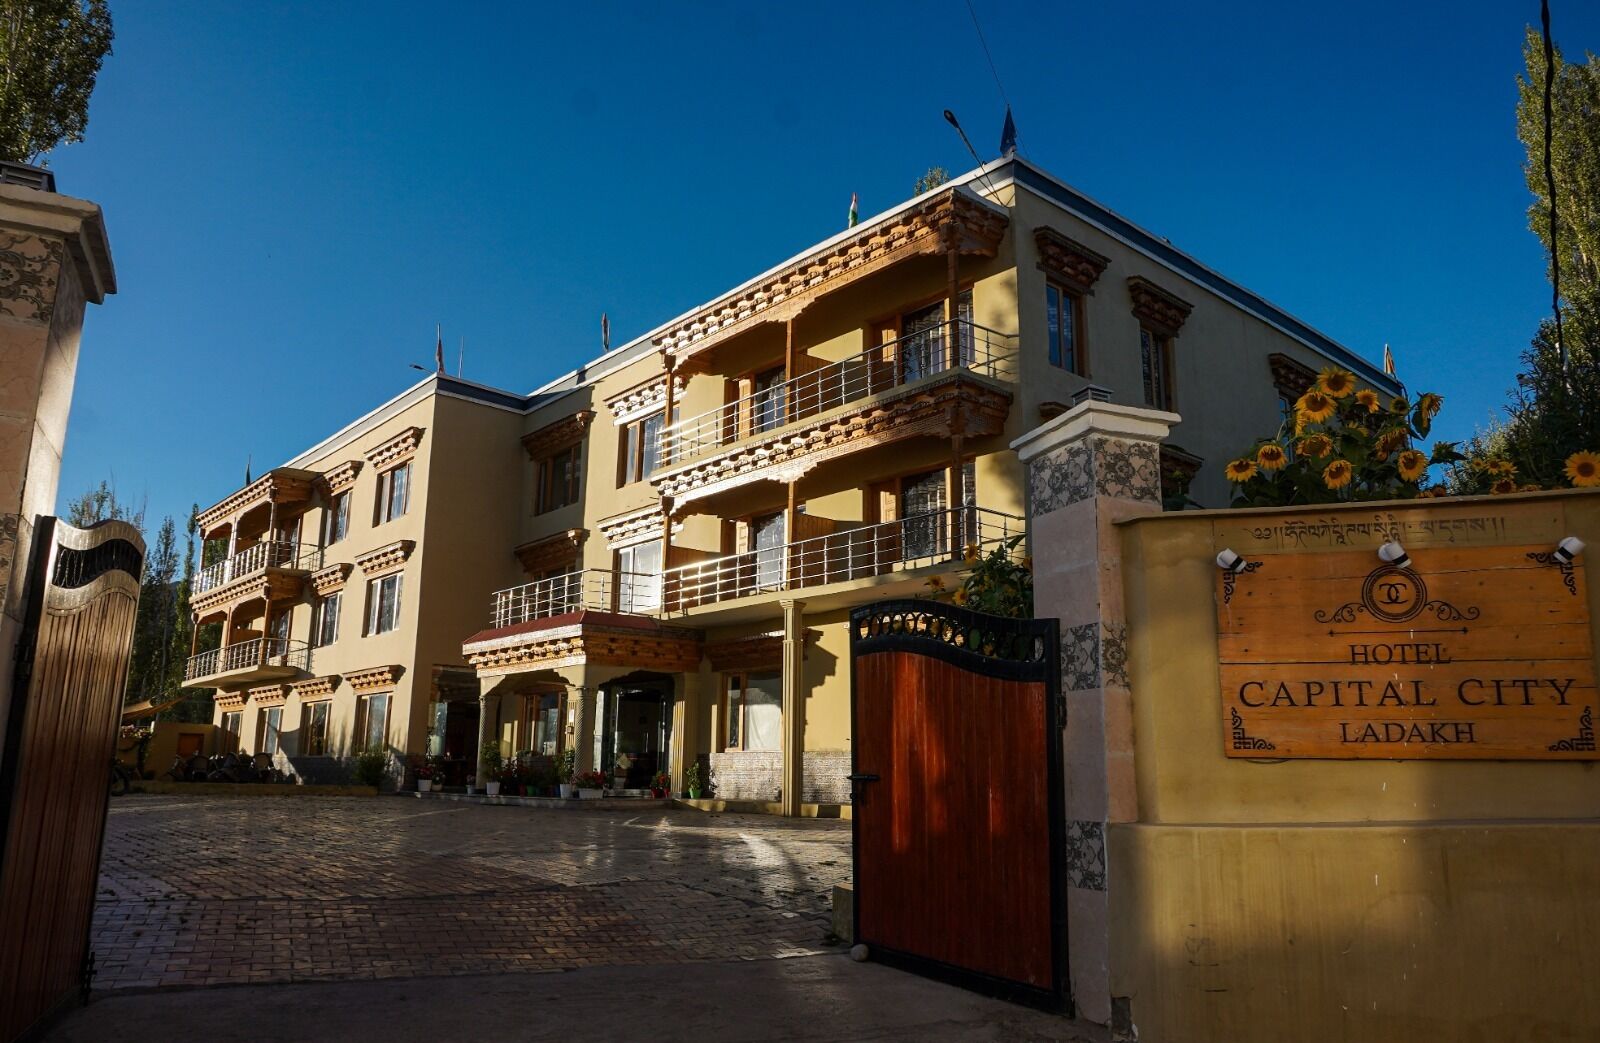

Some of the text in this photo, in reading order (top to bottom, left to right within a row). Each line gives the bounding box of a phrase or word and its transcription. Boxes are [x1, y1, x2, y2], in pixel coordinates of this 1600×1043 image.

[1350, 643, 1451, 666] HOTEL
[1239, 679, 1576, 708] CAPITAL CITY
[1339, 722, 1477, 744] LADAKH
